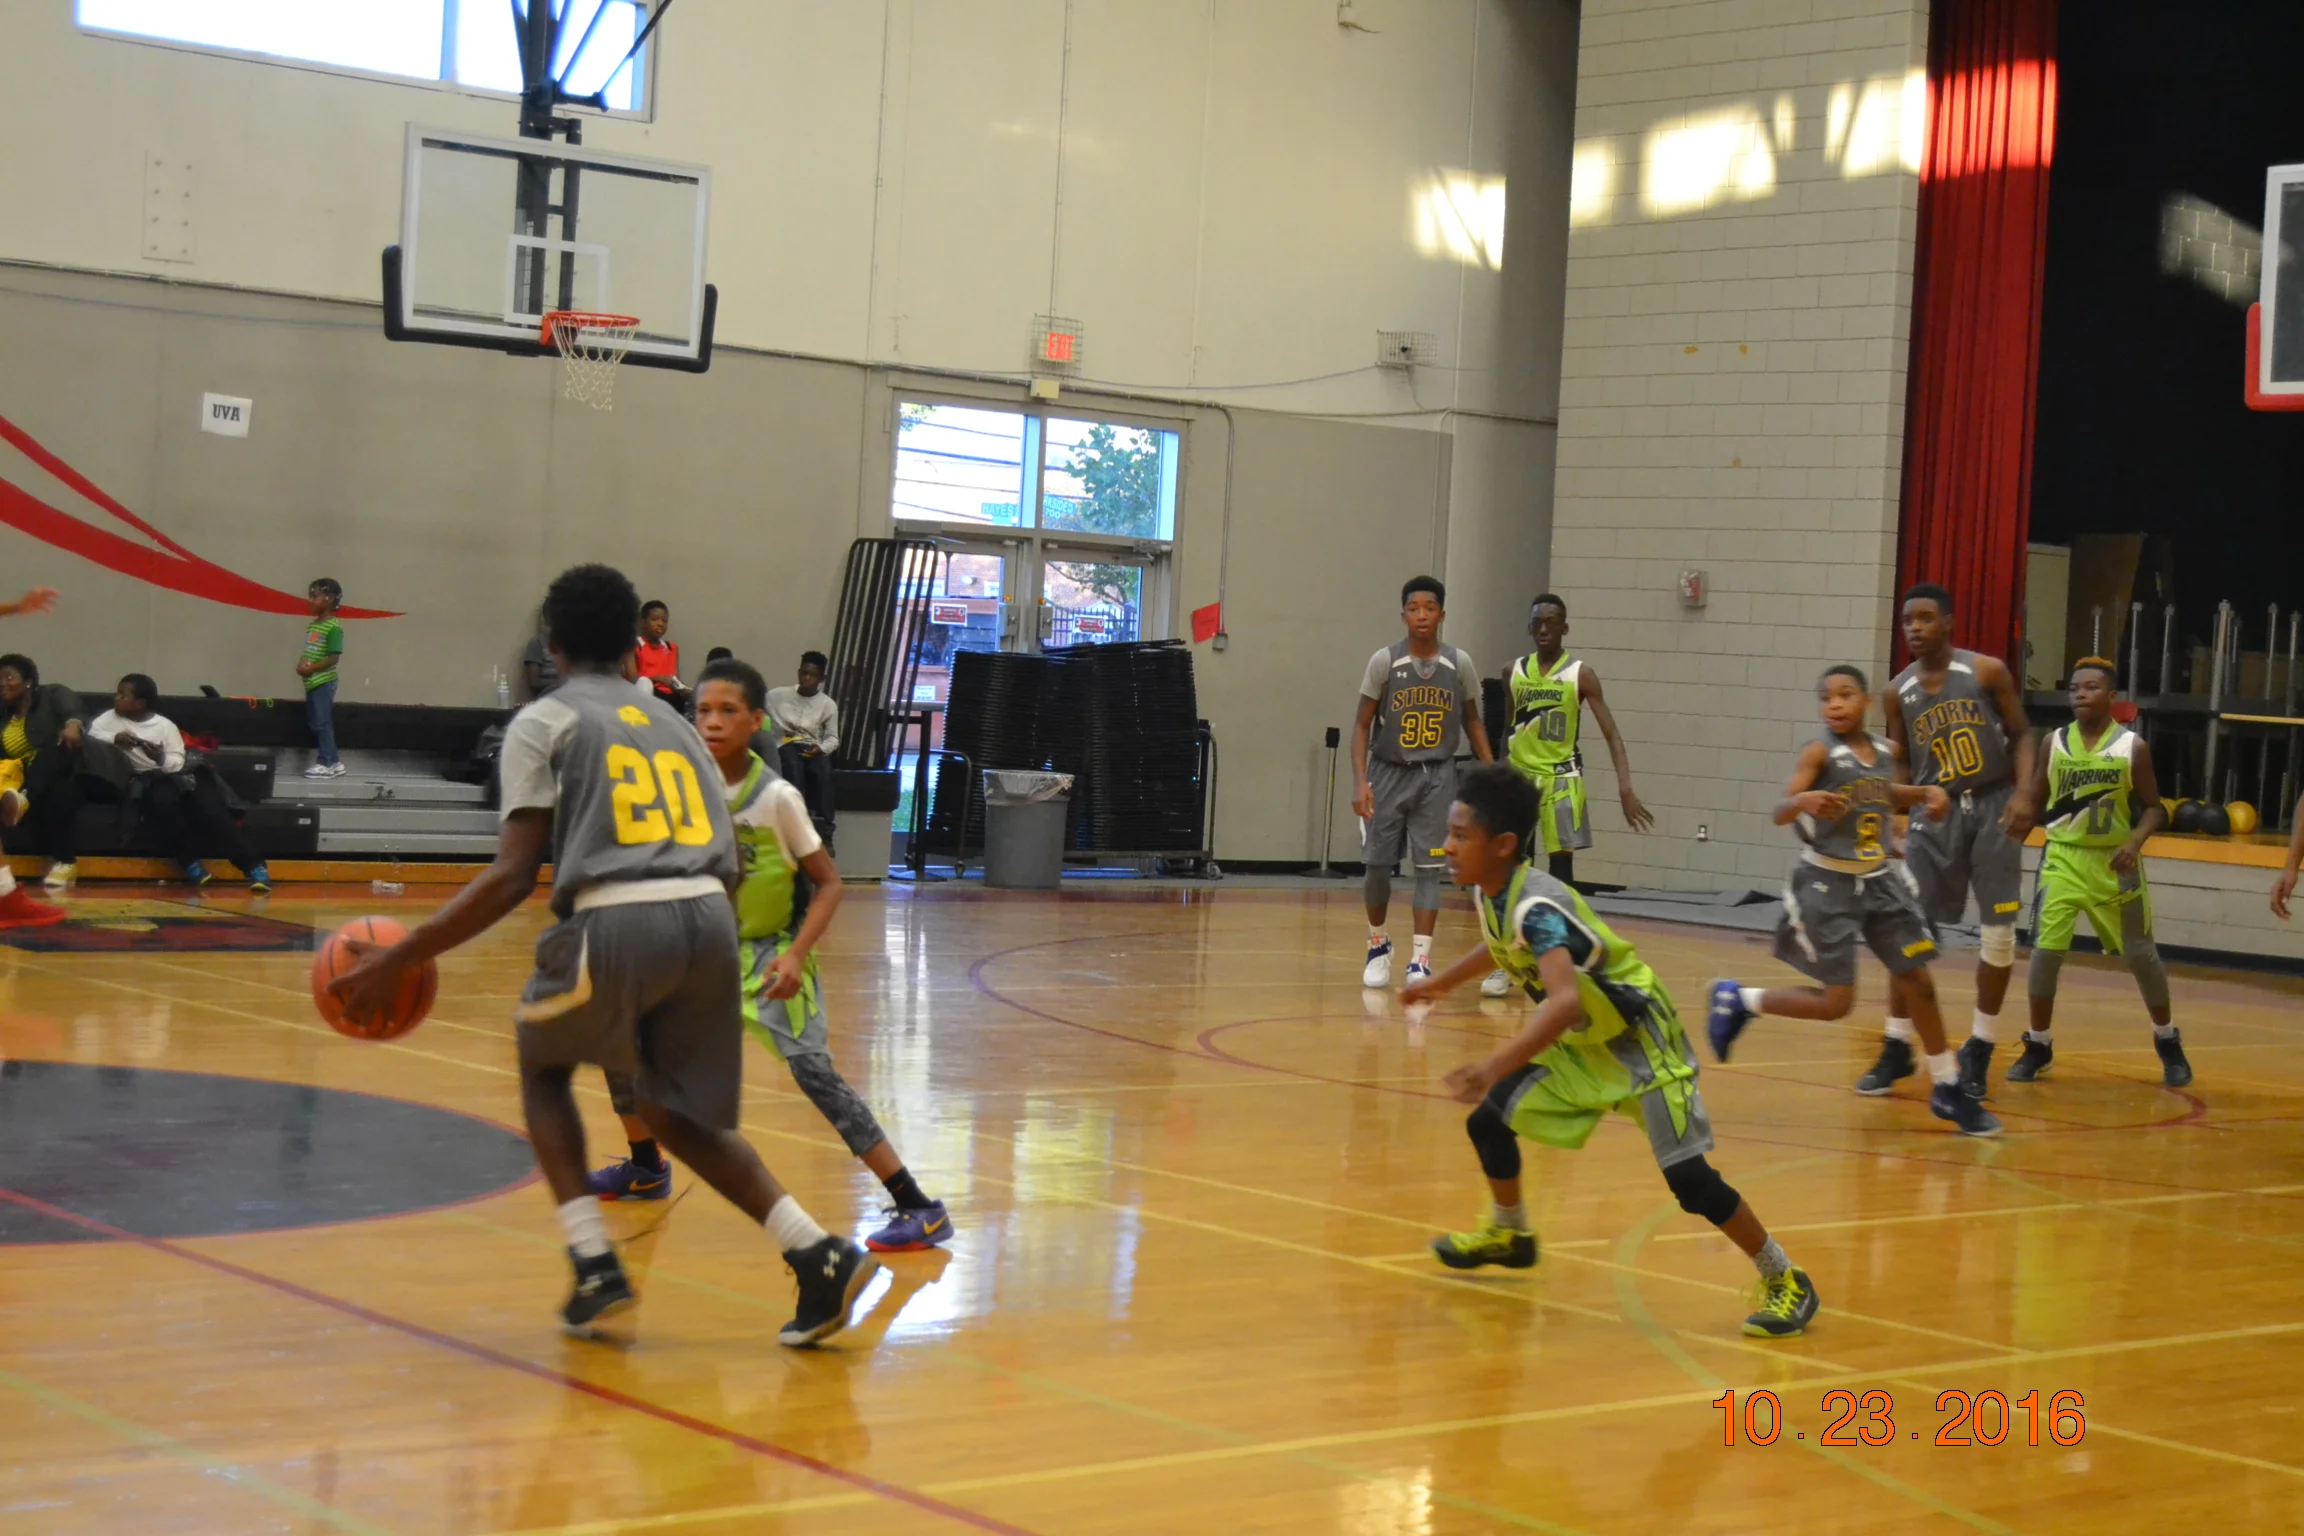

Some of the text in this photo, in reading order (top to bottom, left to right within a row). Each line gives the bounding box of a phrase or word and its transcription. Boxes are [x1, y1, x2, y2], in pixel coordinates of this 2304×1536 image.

[1047, 332, 1075, 360] EXIT
[212, 403, 241, 422] UVA
[982, 503, 1014, 518] HAYES
[1391, 686, 1454, 712] STORM
[1515, 687, 1564, 709] WARRIORS
[1399, 711, 1444, 748] 35
[1913, 699, 1987, 746] STORM
[1931, 727, 1984, 783] 10
[606, 743, 713, 846] 20
[2056, 767, 2121, 797] WARRIORS
